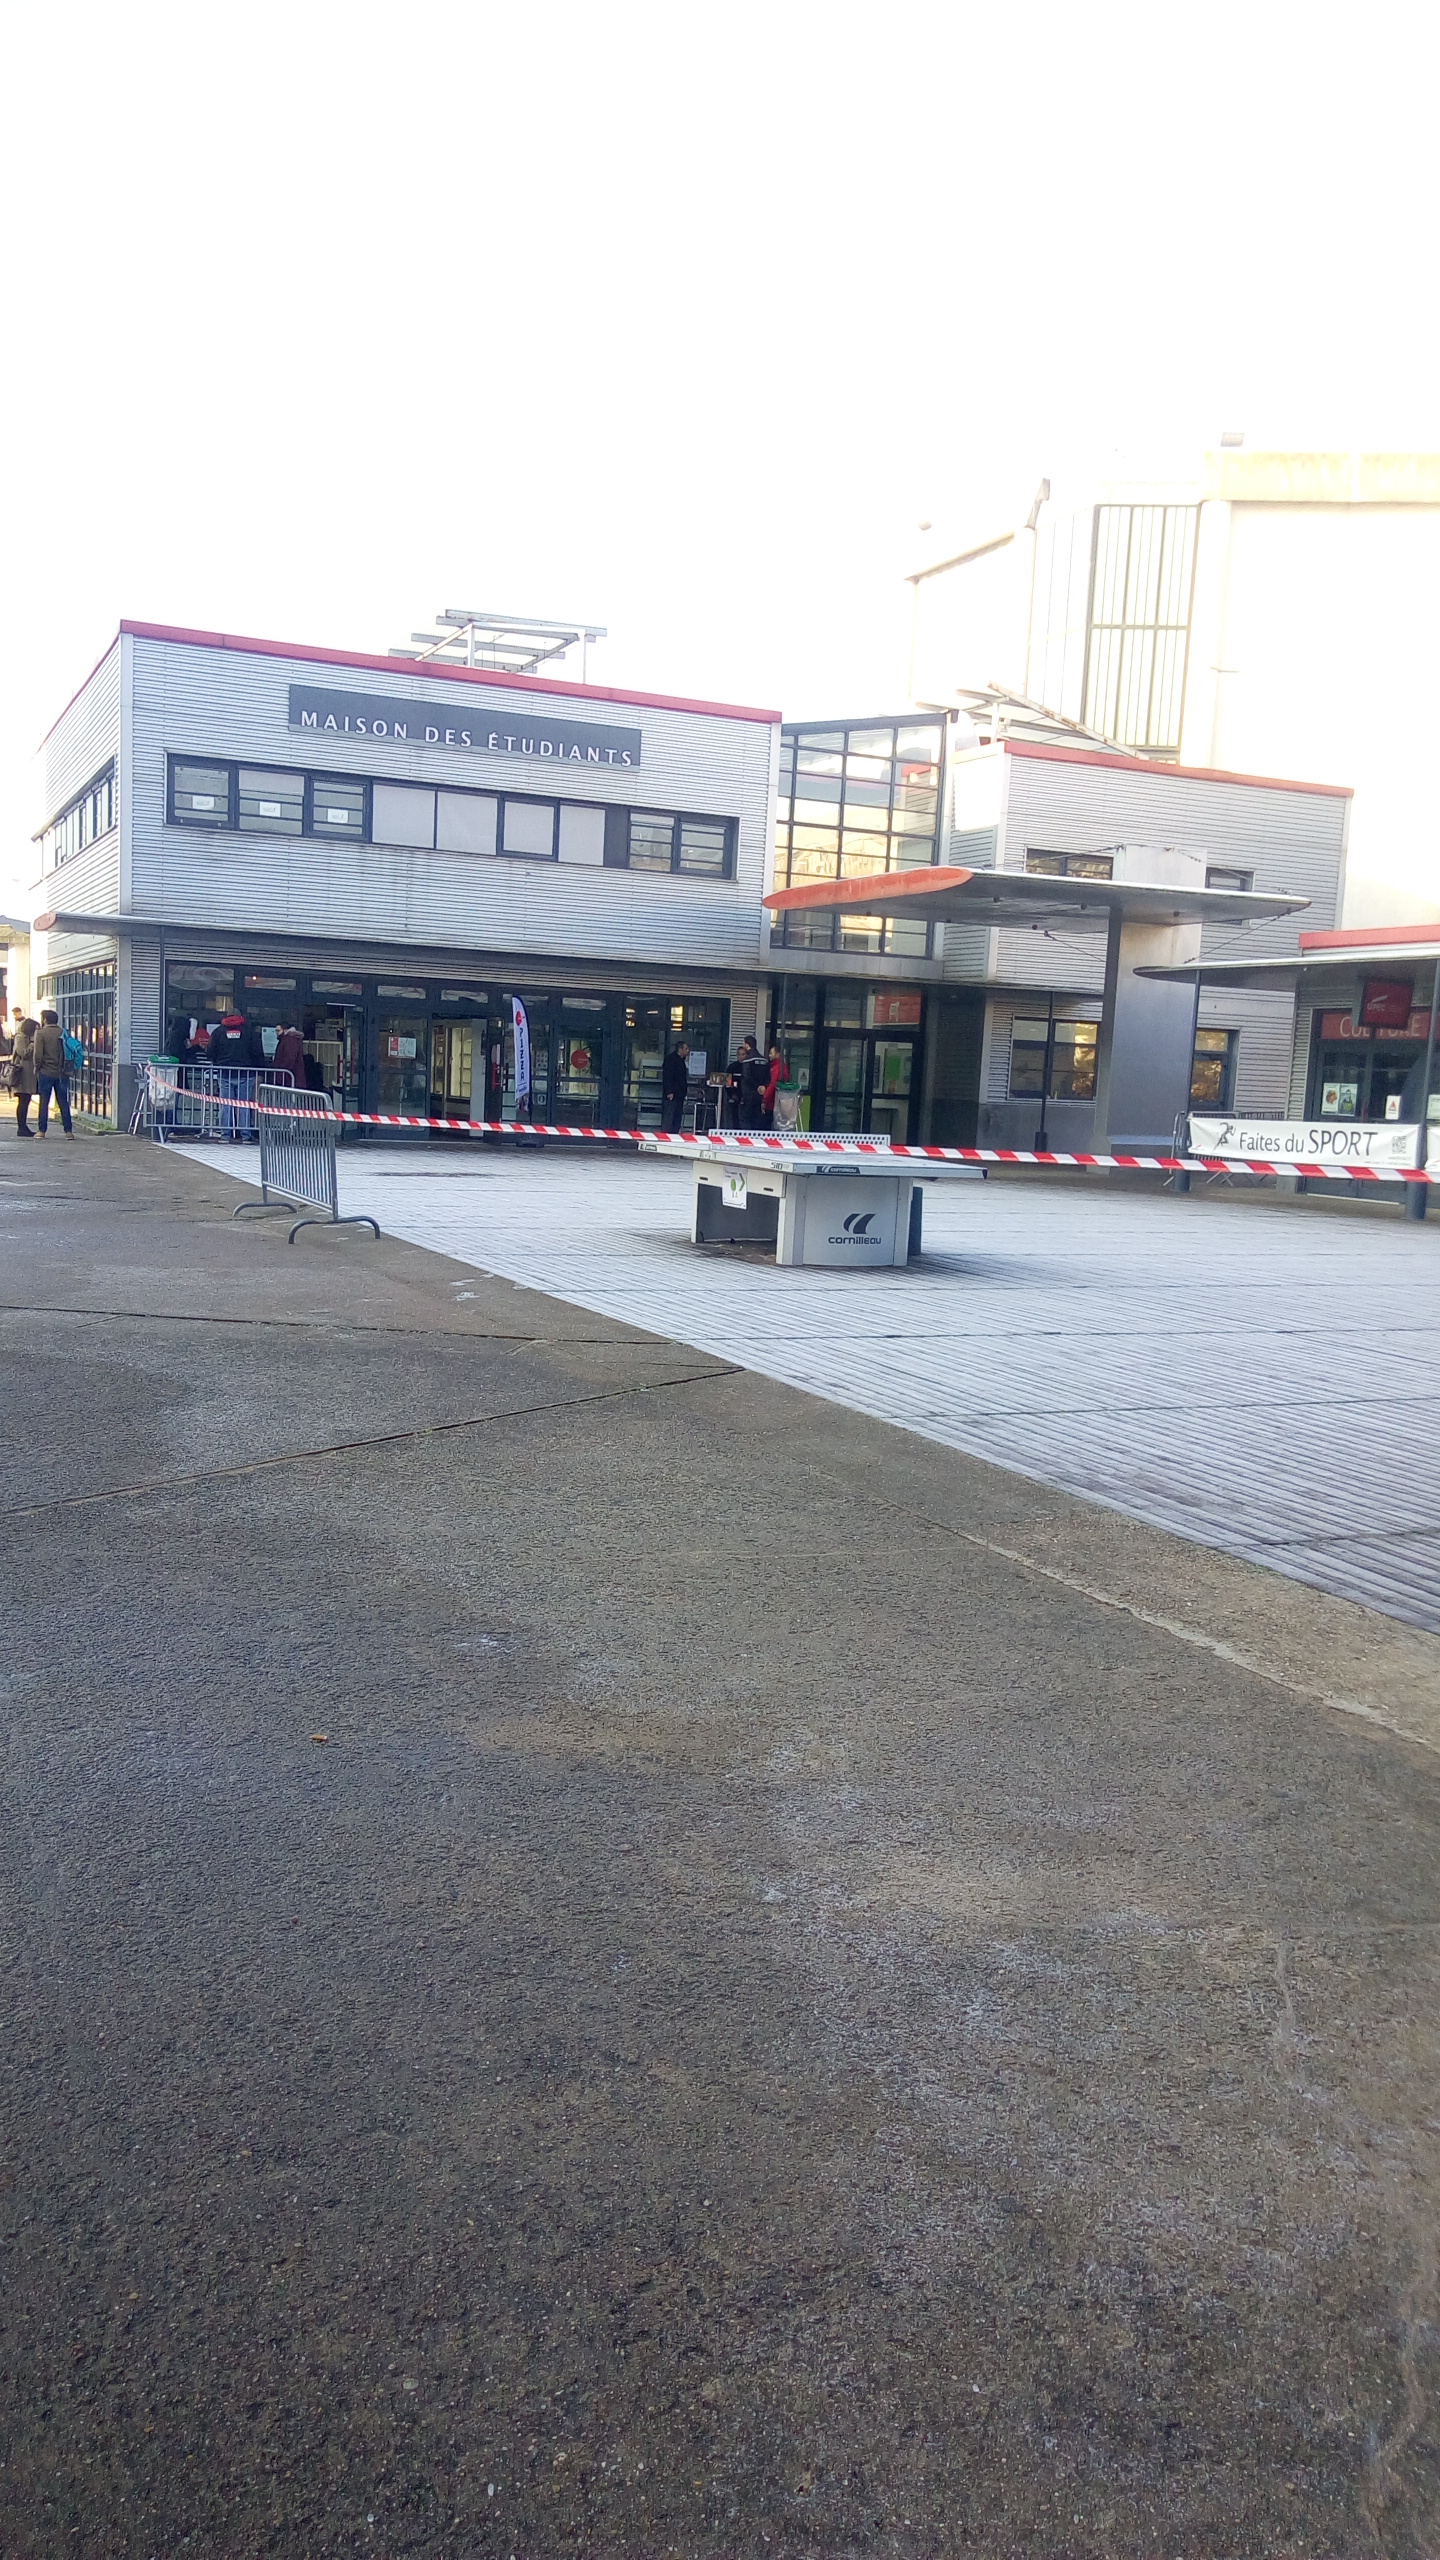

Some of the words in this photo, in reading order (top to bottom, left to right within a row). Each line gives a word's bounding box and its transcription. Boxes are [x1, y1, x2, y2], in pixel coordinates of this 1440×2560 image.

[301, 710, 408, 740] MAISON
[425, 726, 472, 748] DES
[488, 732, 633, 767] ÉTUDIANTS
[1239, 1131, 1280, 1152] Faites
[1285, 1133, 1304, 1153] du
[1308, 1129, 1378, 1156] SPORT
[828, 1236, 881, 1245] cornilleau
